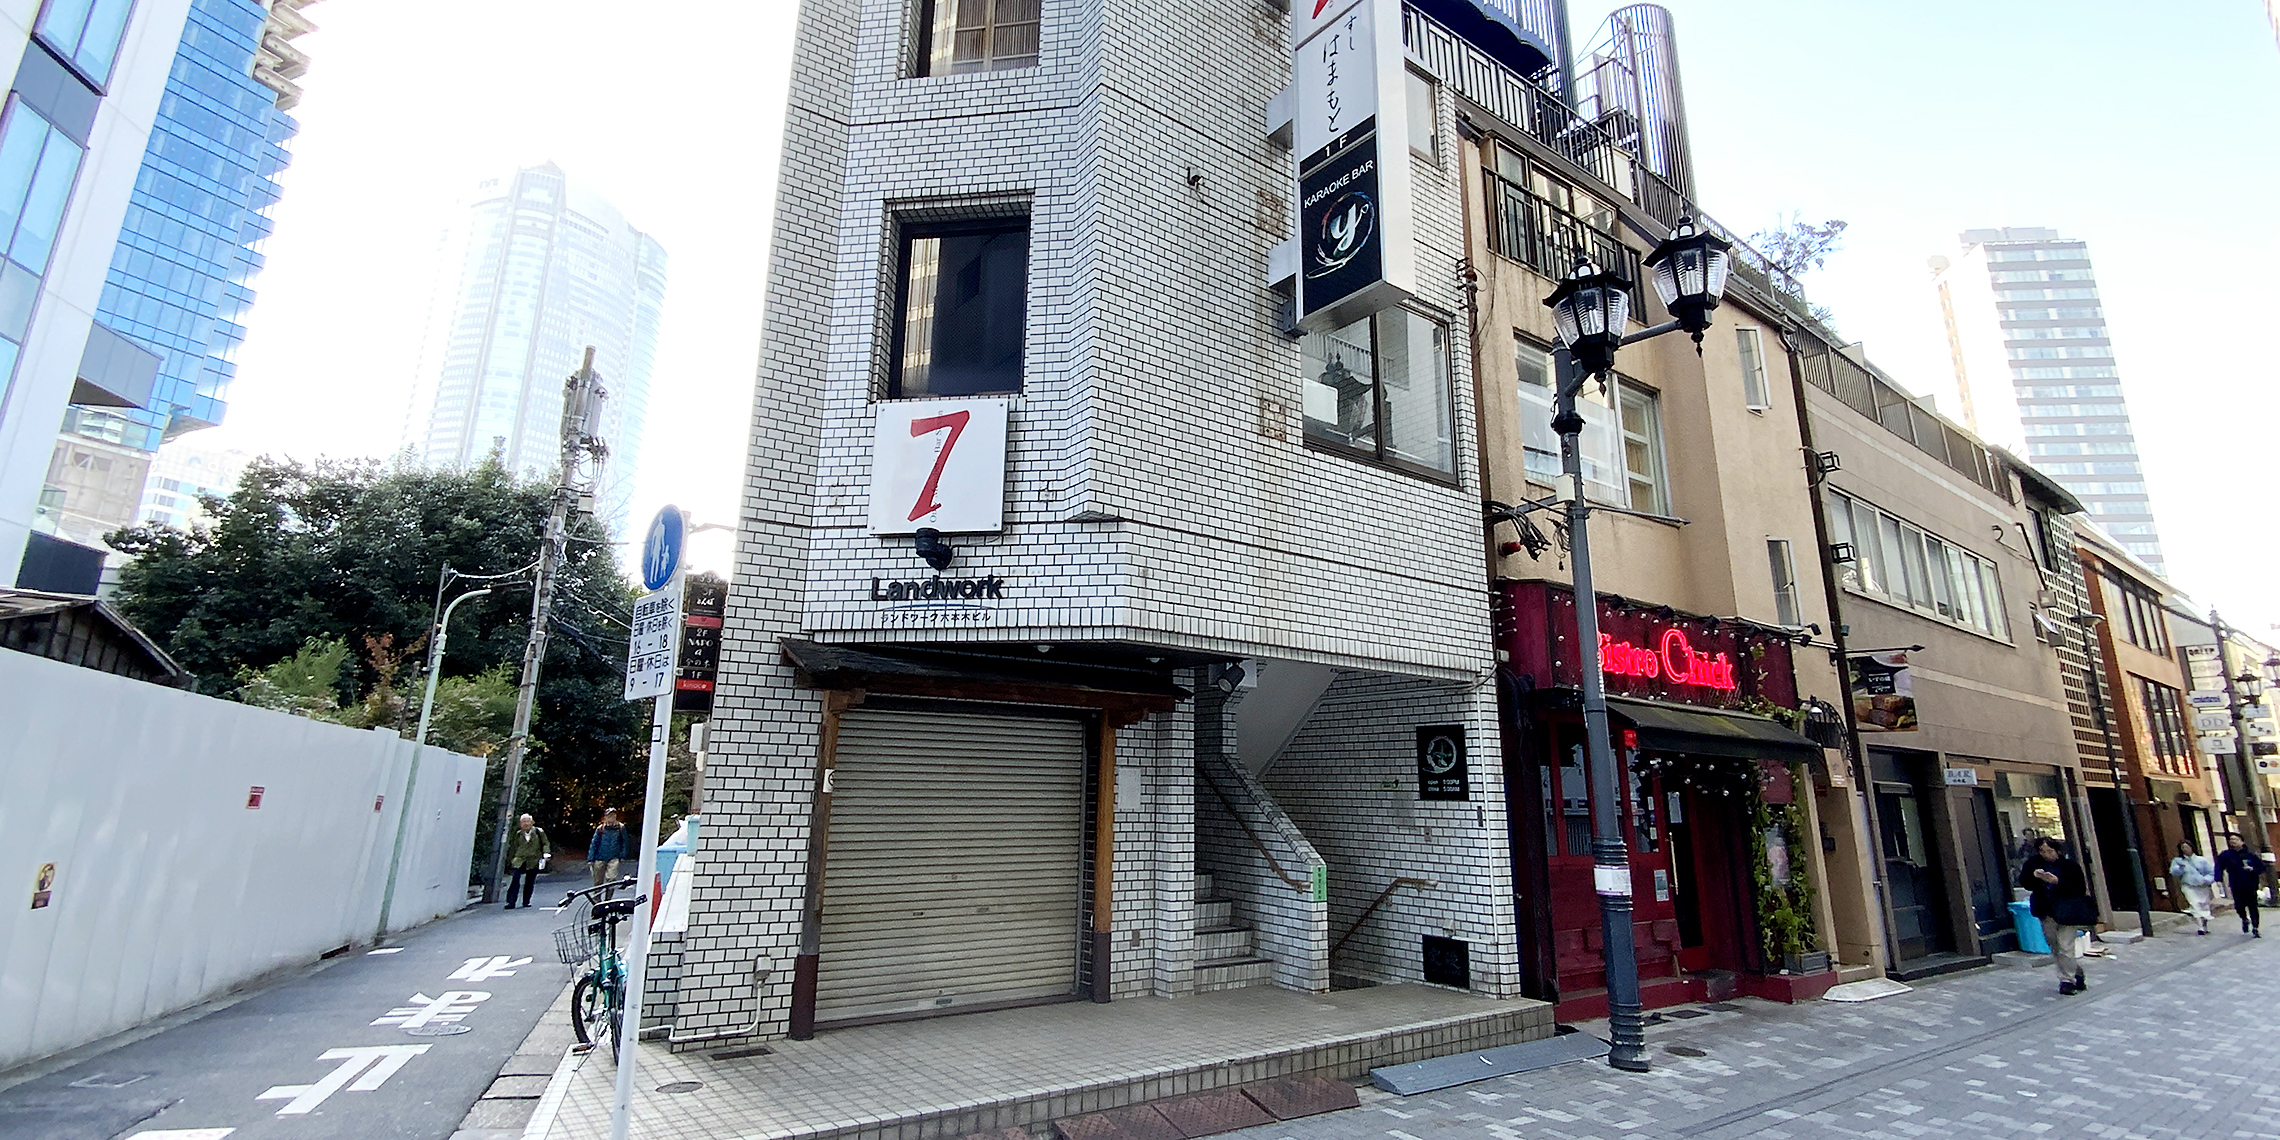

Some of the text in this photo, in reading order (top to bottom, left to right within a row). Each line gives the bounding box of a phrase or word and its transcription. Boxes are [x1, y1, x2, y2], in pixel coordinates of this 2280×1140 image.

[1344, 15, 1357, 50] すし
[1323, 34, 1341, 133] はまもと
[1304, 159, 1374, 209] KARAOKE BAR
[907, 409, 971, 522] 7
[871, 575, 1004, 601] Landwork
[636, 598, 675, 619] 自転車を除く
[634, 640, 642, 655] 16
[660, 634, 668, 650] 18
[696, 628, 708, 637] 2F
[1661, 629, 1735, 690] Chick
[630, 677, 635, 692] 9
[655, 672, 664, 688] 17
[692, 671, 702, 679] 1F
